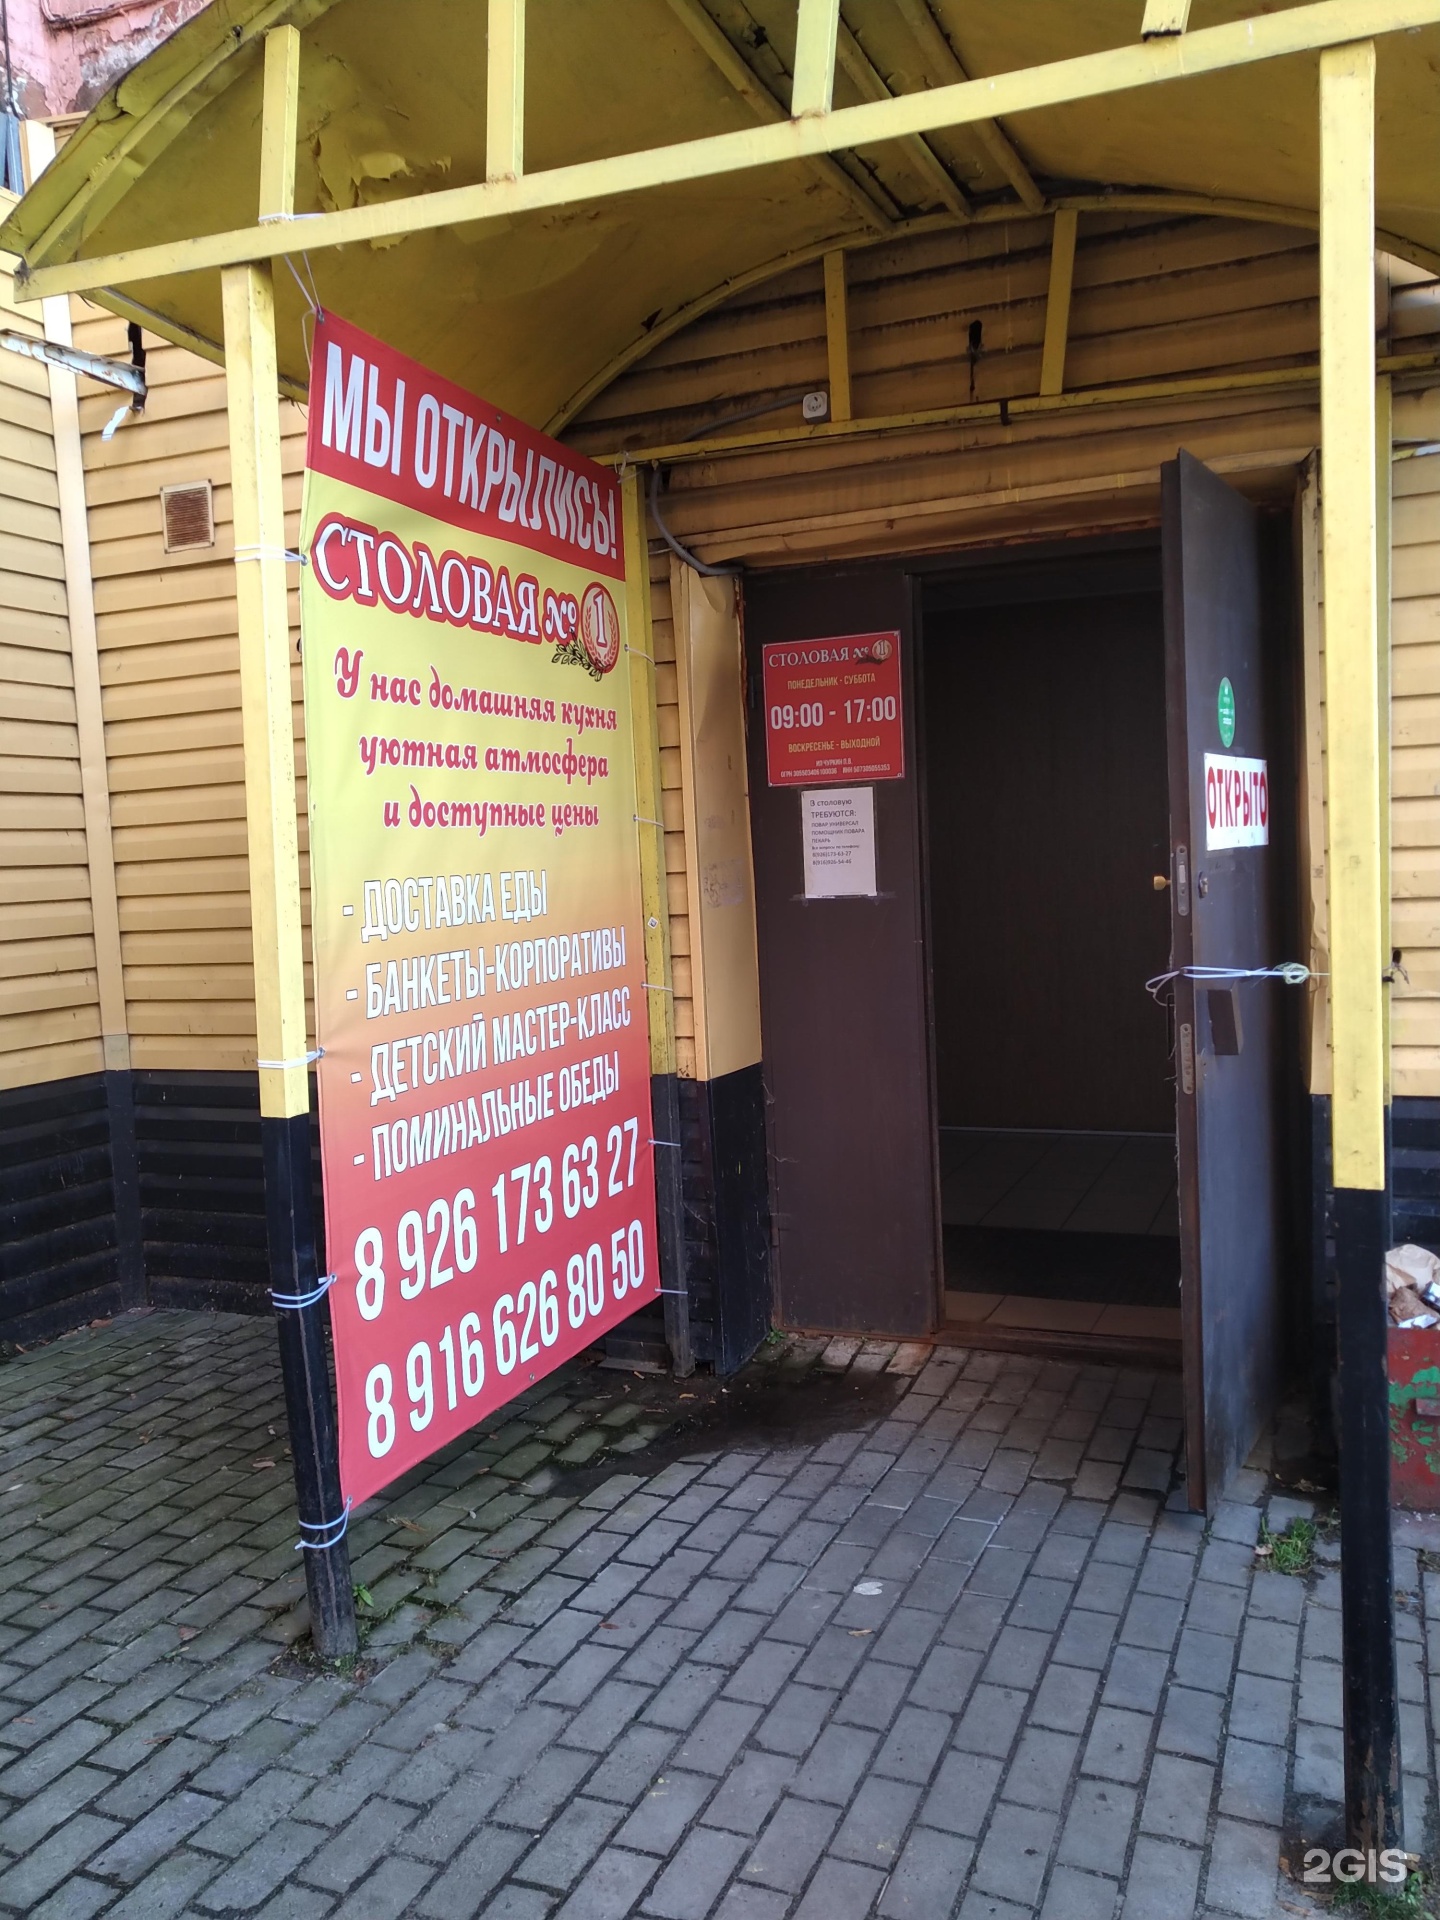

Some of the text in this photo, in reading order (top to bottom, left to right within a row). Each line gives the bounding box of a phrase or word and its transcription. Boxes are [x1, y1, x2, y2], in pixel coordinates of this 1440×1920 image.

[321, 341, 617, 560] МЫ ОТКРЫЛИСЬ!
[315, 521, 540, 638] СТОЛОВАЯ
[335, 647, 617, 735] У нас домашняя кухня
[769, 647, 849, 668] СТОЛОВАЯ
[788, 677, 838, 691] ПОНЕДЕЛЬНИК
[844, 673, 876, 685] СУББОТА
[771, 703, 823, 730] 09:00
[844, 696, 896, 724] 17:00
[788, 741, 835, 754] ВОСКРЕСЕНЬЕ
[841, 736, 880, 750] ВЫХОДНОЙ
[359, 736, 609, 785] уютная атмосфера
[383, 784, 599, 837] и доступные цены
[811, 810, 857, 818] ТРЕБУЮТСЯ:
[816, 799, 852, 807] столовую
[1207, 766, 1267, 829] ОТКРЫТО
[343, 869, 548, 943] - ДОСТАВКА ЕДЫ
[346, 925, 626, 1019] - БАНКЕТЫ-КОРПОРАТИВЫ
[350, 986, 631, 1107] - ДЕТСКИЙ МАСТЕР-КЛАСС
[353, 1051, 619, 1181] - ПОМИНАЛЬНЫЕ ОБЕДЫ
[354, 1116, 639, 1321] 8 926 173 63 27
[365, 1219, 645, 1459] 8 916 626 80 50
